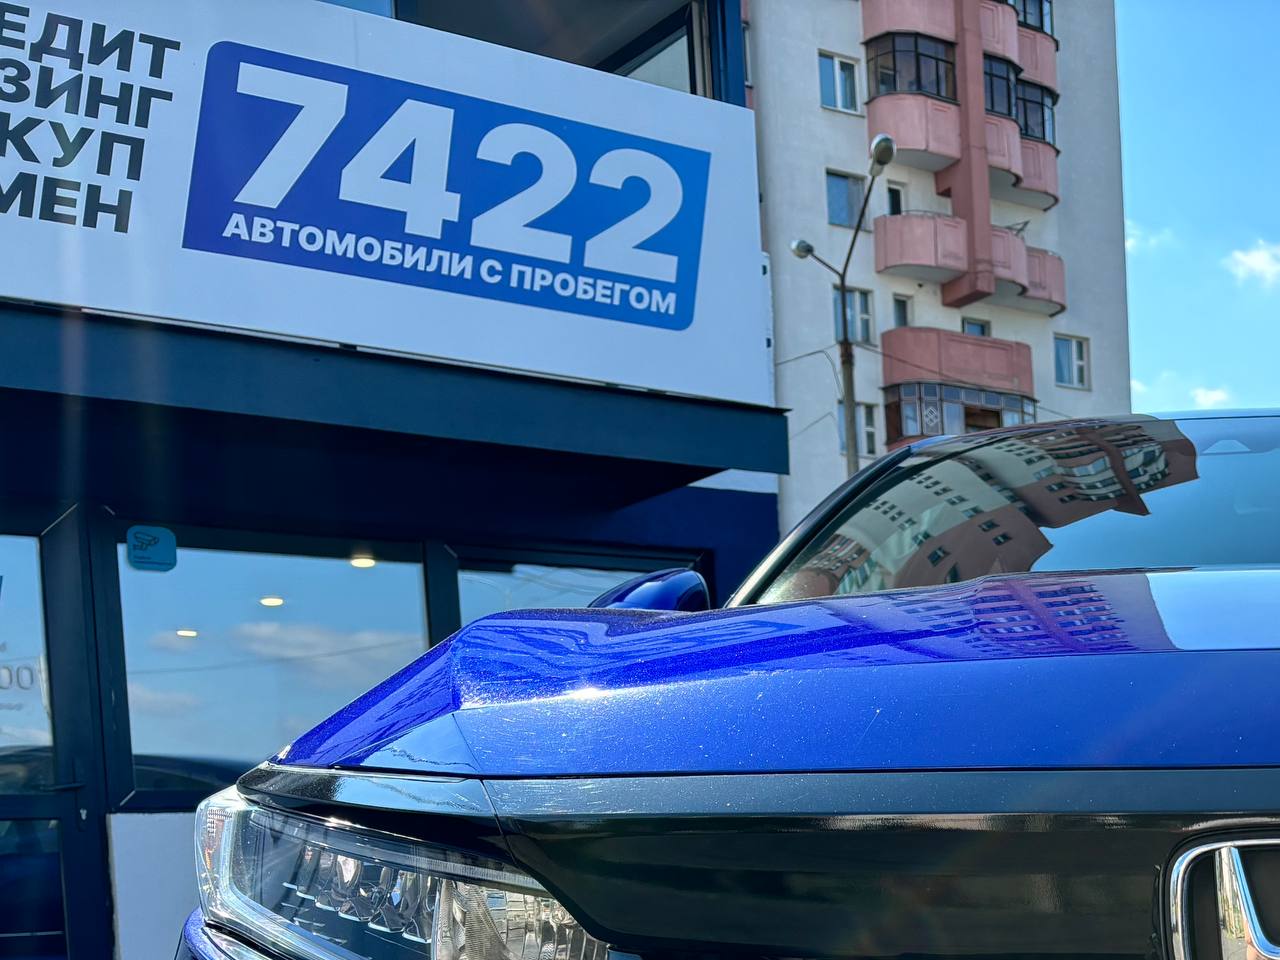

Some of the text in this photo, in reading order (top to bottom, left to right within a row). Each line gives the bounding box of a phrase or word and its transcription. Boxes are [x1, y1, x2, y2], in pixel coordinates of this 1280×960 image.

[234, 61, 684, 283] 7422
[222, 212, 677, 315] АВТОМОБИЛИ С ПРОБЕГОМ
